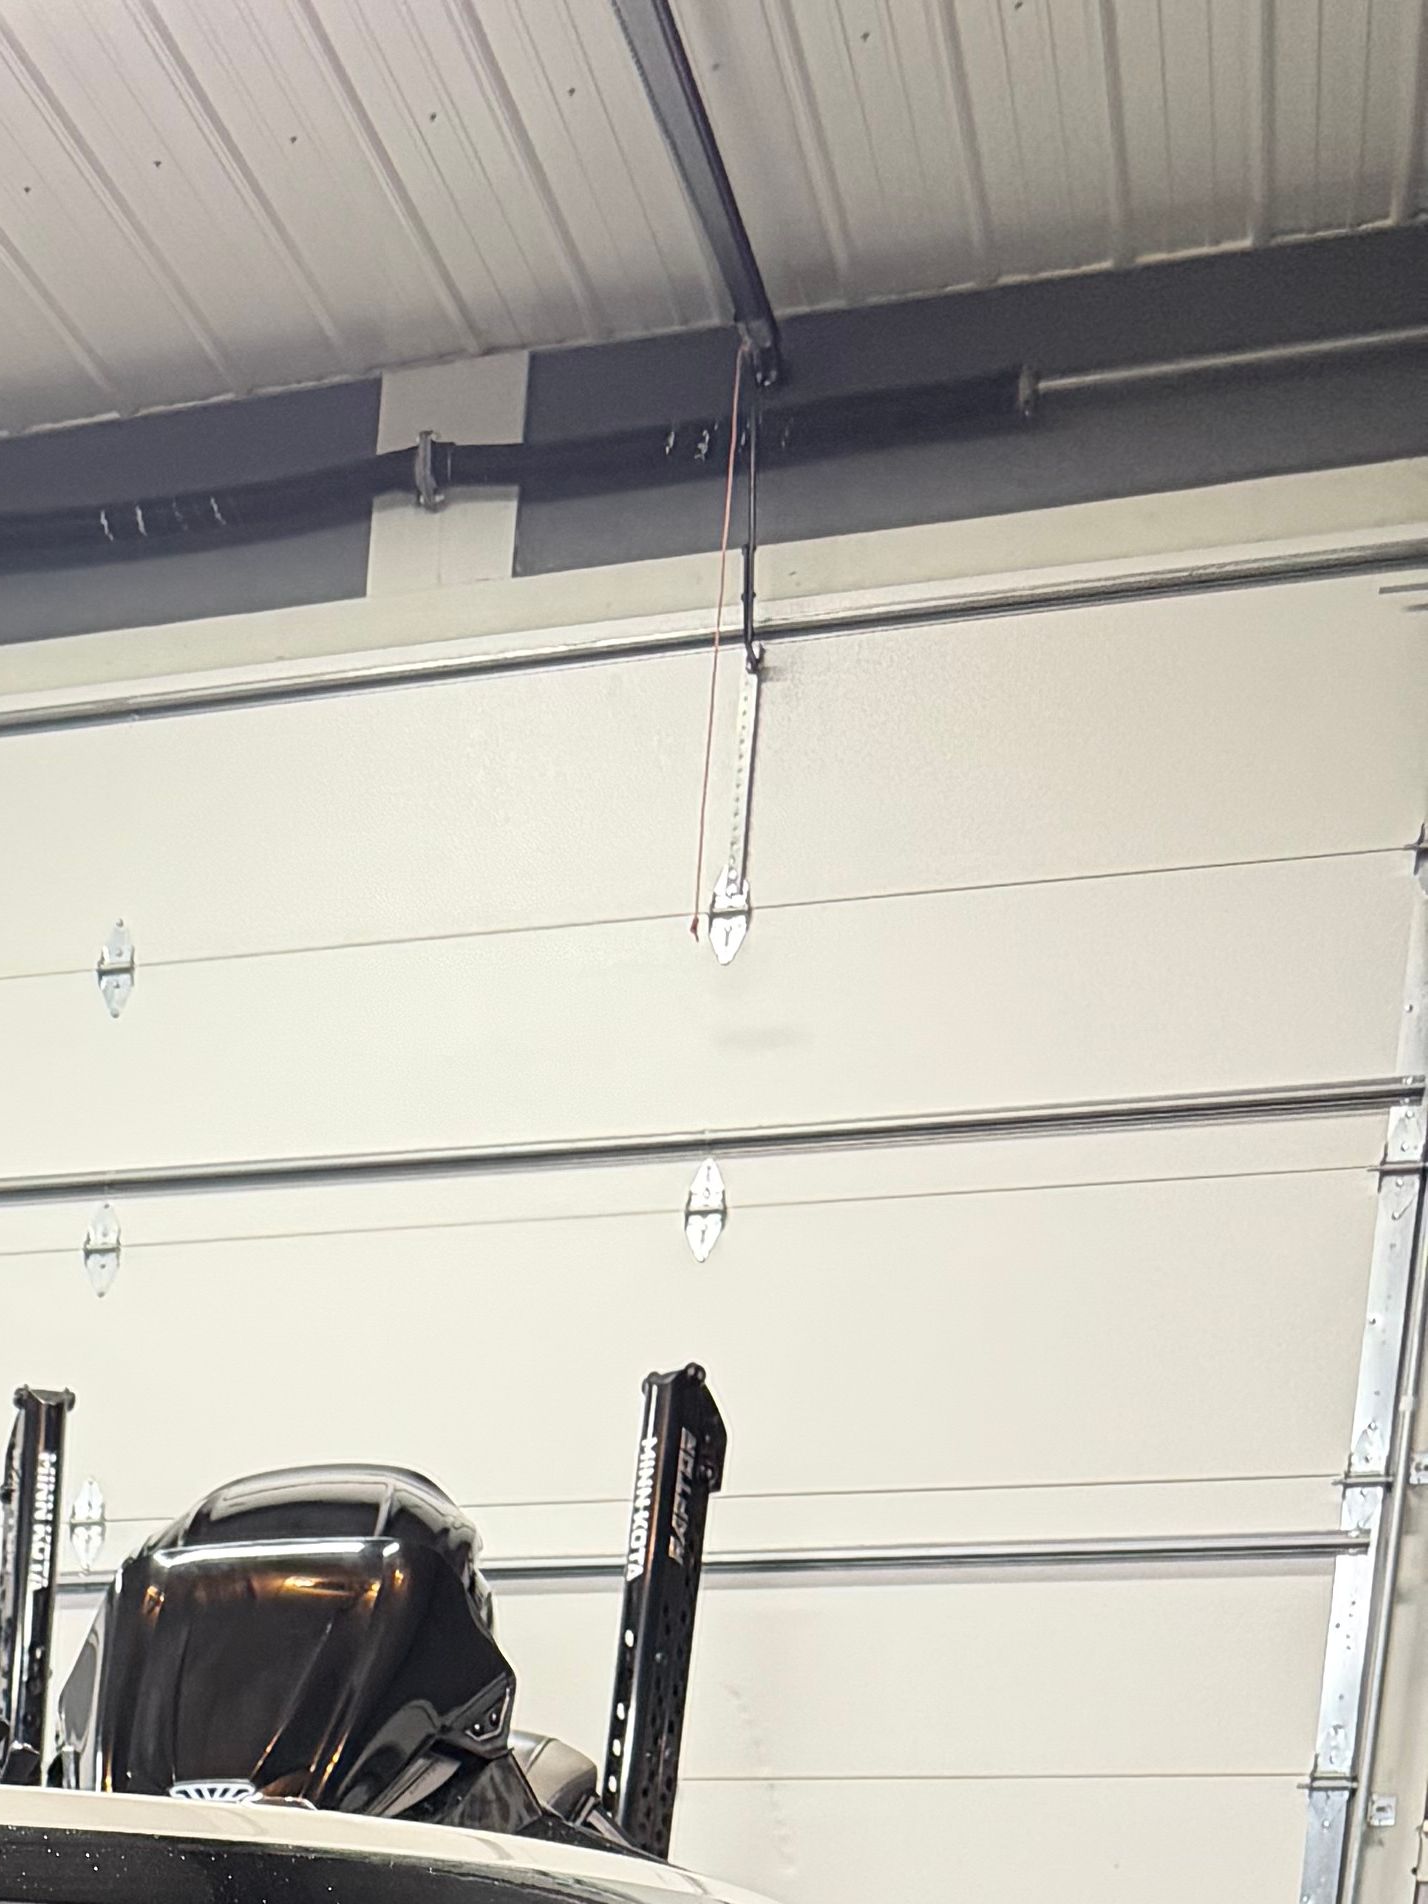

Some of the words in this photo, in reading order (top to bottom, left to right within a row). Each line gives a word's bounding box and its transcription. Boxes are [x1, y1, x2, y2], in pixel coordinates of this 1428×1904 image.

[636, 1436, 658, 1507] MINN
[669, 1427, 697, 1566] RAPTOR
[627, 1511, 650, 1582] KOTA
